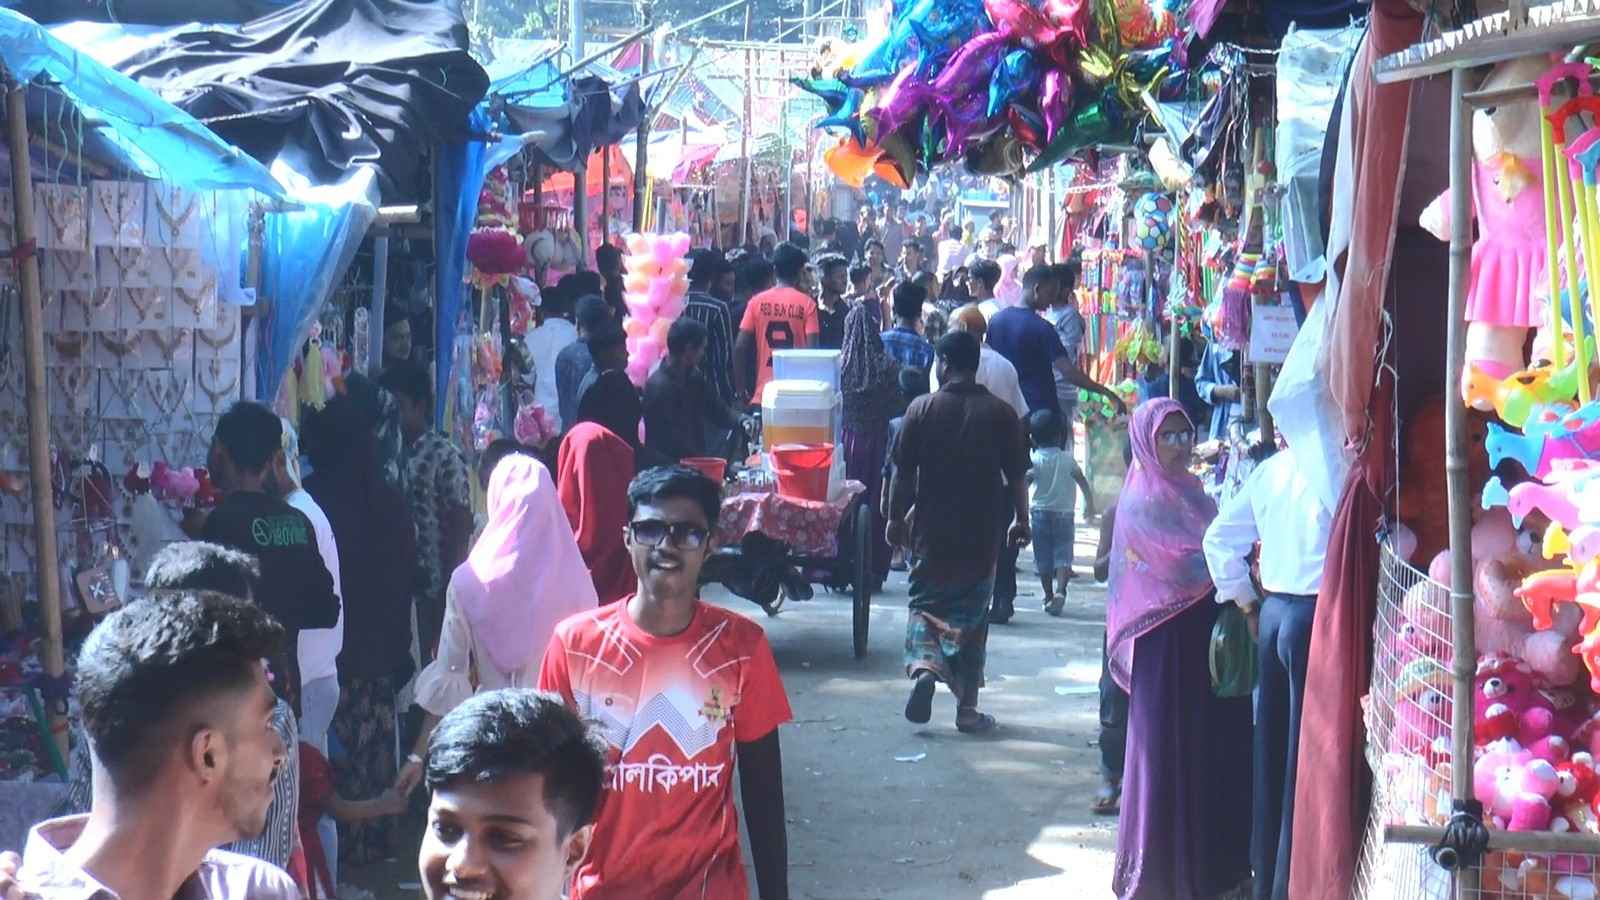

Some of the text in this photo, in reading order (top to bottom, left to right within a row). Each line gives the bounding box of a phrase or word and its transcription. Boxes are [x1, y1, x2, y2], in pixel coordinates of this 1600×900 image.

[760, 302, 805, 320] RED SUN CLUB
